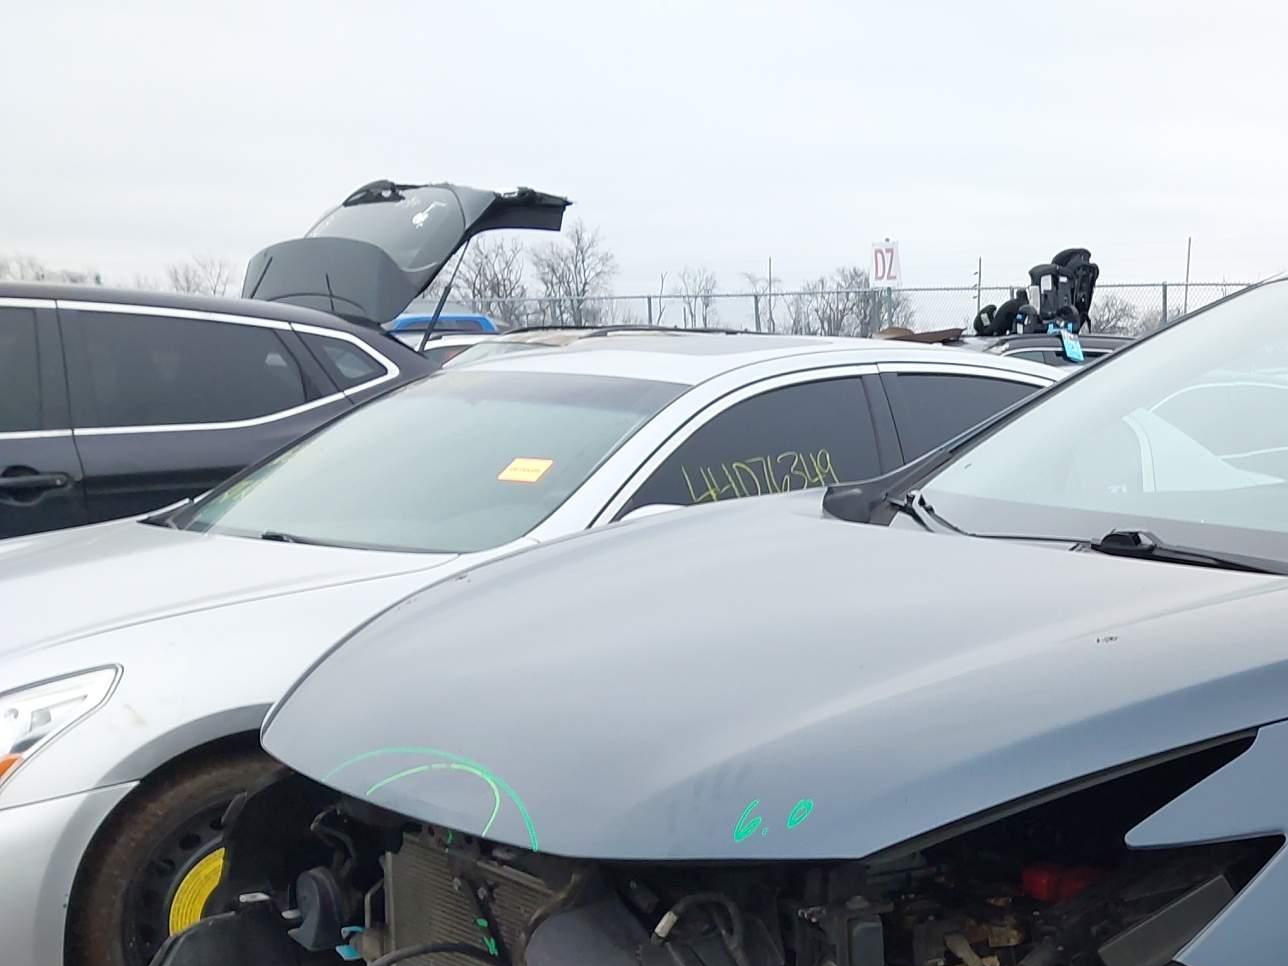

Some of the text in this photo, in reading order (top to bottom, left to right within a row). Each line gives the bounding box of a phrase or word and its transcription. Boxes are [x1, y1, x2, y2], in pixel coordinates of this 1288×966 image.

[874, 247, 897, 281] DZ
[680, 448, 840, 502] 44076349
[734, 798, 814, 843] 6.0
